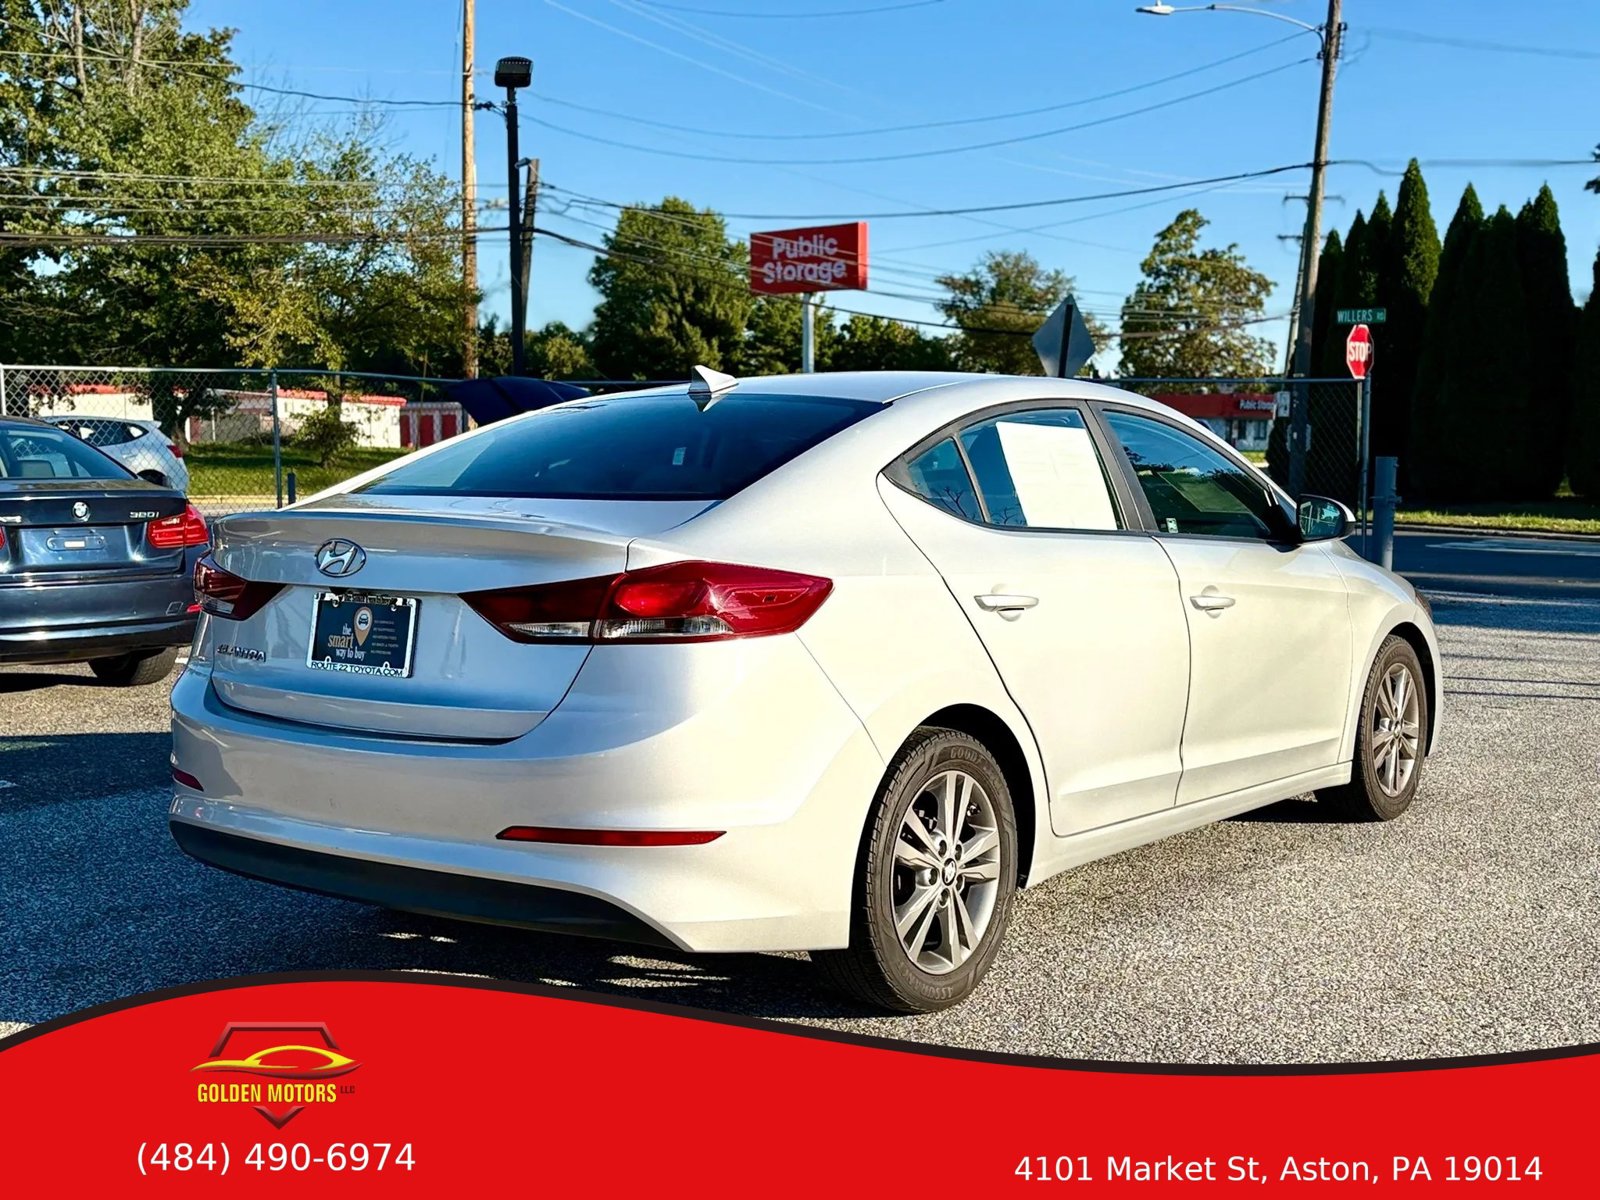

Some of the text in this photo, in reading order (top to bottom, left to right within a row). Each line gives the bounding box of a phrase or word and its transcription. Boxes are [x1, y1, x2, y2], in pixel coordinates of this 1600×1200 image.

[772, 235, 838, 259] Public
[763, 261, 847, 284] Storage
[1337, 309, 1373, 322] WILLERS
[1349, 342, 1372, 362] STOP
[342, 623, 352, 635] the
[327, 634, 354, 649] smart
[217, 644, 266, 662] ELANTRA
[335, 646, 365, 661] way to buy
[311, 661, 337, 671] ROUTE
[337, 663, 349, 672] 22
